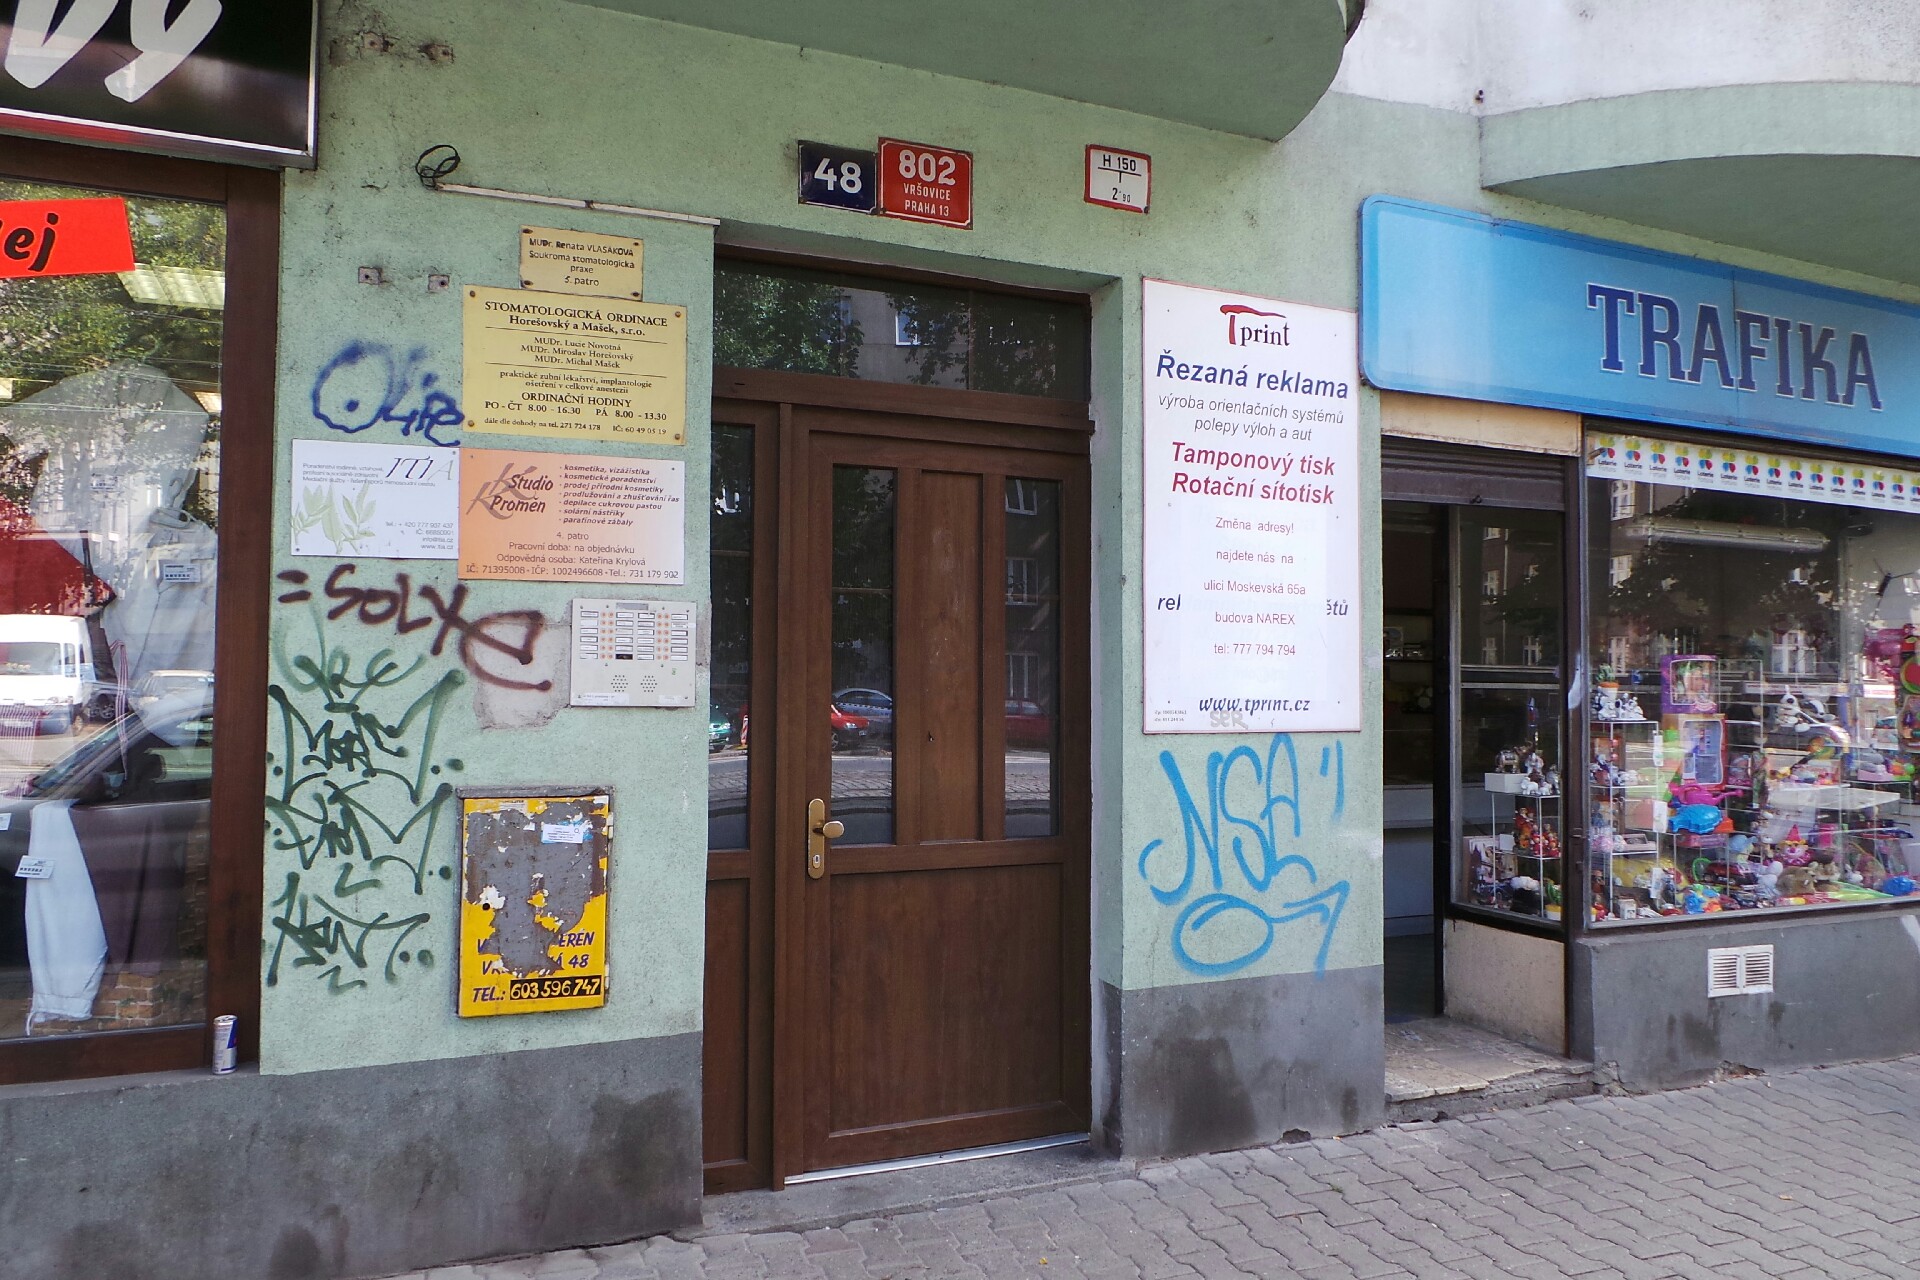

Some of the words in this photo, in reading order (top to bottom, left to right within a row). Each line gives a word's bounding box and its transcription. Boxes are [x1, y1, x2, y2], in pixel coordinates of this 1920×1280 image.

[899, 149, 956, 187] 802
[1102, 154, 1111, 167] H
[1117, 157, 1136, 172] 150
[813, 157, 862, 194] 48
[903, 182, 951, 201] VRŠOVICE
[904, 199, 936, 216] PRAHA
[938, 204, 950, 217] 13
[0, 213, 56, 272] ej
[529, 237, 553, 248] MUDr.
[556, 241, 585, 251] Renata
[570, 265, 594, 273] praxe
[574, 277, 600, 287] patro
[484, 301, 602, 320] STOMATOLOGICKÁ
[607, 312, 668, 327] ORDINACE
[509, 315, 570, 330] Horešovský
[582, 321, 618, 334] Mašek,
[620, 328, 646, 336] s.r.o.
[534, 336, 562, 346] MUDr.
[588, 341, 621, 351] Novotná
[1586, 282, 1883, 411] TRAFIKA
[521, 345, 550, 354] MUDr.
[552, 347, 586, 356] Miroslav
[589, 351, 634, 361] Horešovský
[535, 354, 563, 364] MUDr.
[566, 358, 592, 366] Michal
[594, 360, 621, 369] Mašek
[500, 370, 538, 379] praktické
[540, 372, 561, 381] zubní
[600, 377, 652, 388] implantologie
[1156, 349, 1248, 388] Řezaná
[1256, 370, 1348, 399] reklama
[525, 380, 557, 389] ošetření
[565, 383, 594, 391] celkové
[521, 392, 585, 404] ORDINAČNÍ
[587, 396, 632, 407] HODINY
[485, 401, 499, 409] PO
[507, 400, 522, 411] ČT
[528, 404, 547, 412] 8.00
[557, 406, 581, 415] 16.30
[595, 407, 609, 417] PÁ
[615, 410, 634, 418] 8.00
[644, 412, 667, 420] 13.30
[1158, 393, 1204, 410] výroba
[1208, 399, 1288, 419] orientačních
[1291, 409, 1344, 425] systémů
[512, 419, 537, 428] dohody
[1194, 416, 1239, 435] polepy
[1243, 420, 1276, 439] výloh
[1279, 428, 1287, 438] a
[1292, 428, 1312, 442] aut
[1172, 441, 1294, 477] Tamponový
[1300, 455, 1335, 476] tisk
[564, 464, 607, 473] kosmetika,
[609, 467, 650, 475] vizážistika
[508, 474, 554, 491] Studio
[564, 472, 609, 481] kosmetické
[610, 476, 657, 484] poradenství
[563, 482, 590, 491] prodej
[591, 483, 623, 491] přírodní
[624, 485, 664, 494] kosmetiky
[563, 491, 615, 499] prodlužování
[1172, 472, 1256, 499] Rotační
[1260, 480, 1335, 505] sítotisk
[489, 495, 546, 513] Proměn
[563, 499, 597, 508] depilace
[598, 501, 635, 509] cukrovou
[592, 509, 625, 518] nástřiky
[607, 518, 633, 527] zábaly
[1215, 516, 1252, 530] Změna
[1257, 521, 1294, 536] adresy!
[556, 531, 564, 539] 4.
[567, 532, 590, 541] patro
[508, 541, 546, 550] Pracovní
[547, 542, 571, 551] doba:
[587, 544, 635, 554] objednávku
[496, 553, 546, 563] Odpovědná
[548, 556, 576, 564] osoba:
[579, 556, 614, 565] Kateřina
[615, 557, 646, 567] Krylová
[1216, 550, 1254, 564] najdete
[1257, 551, 1275, 564] nás
[1281, 555, 1294, 564] na
[466, 562, 479, 573] IČ:
[482, 565, 526, 574] 71395008
[531, 564, 549, 575] IČP:
[552, 567, 603, 577] 1002496608
[608, 568, 626, 577] Tel.:
[629, 569, 644, 578] 731
[647, 570, 662, 579] 179
[664, 570, 679, 579] 902
[1203, 579, 1224, 592] ulici
[1227, 580, 1284, 594] Moskevská
[1287, 583, 1306, 595] 65a
[1215, 611, 1254, 624] budova
[1256, 613, 1295, 625] NAREX
[1232, 643, 1251, 655] 777
[1255, 643, 1274, 655] 794
[1277, 644, 1296, 656] 794
[1199, 697, 1310, 716] www.tprint.cz
[568, 953, 590, 969] 48
[472, 986, 506, 1003] TEL.:
[510, 981, 539, 999] 603
[540, 980, 572, 997] 596
[572, 978, 601, 996] 747
